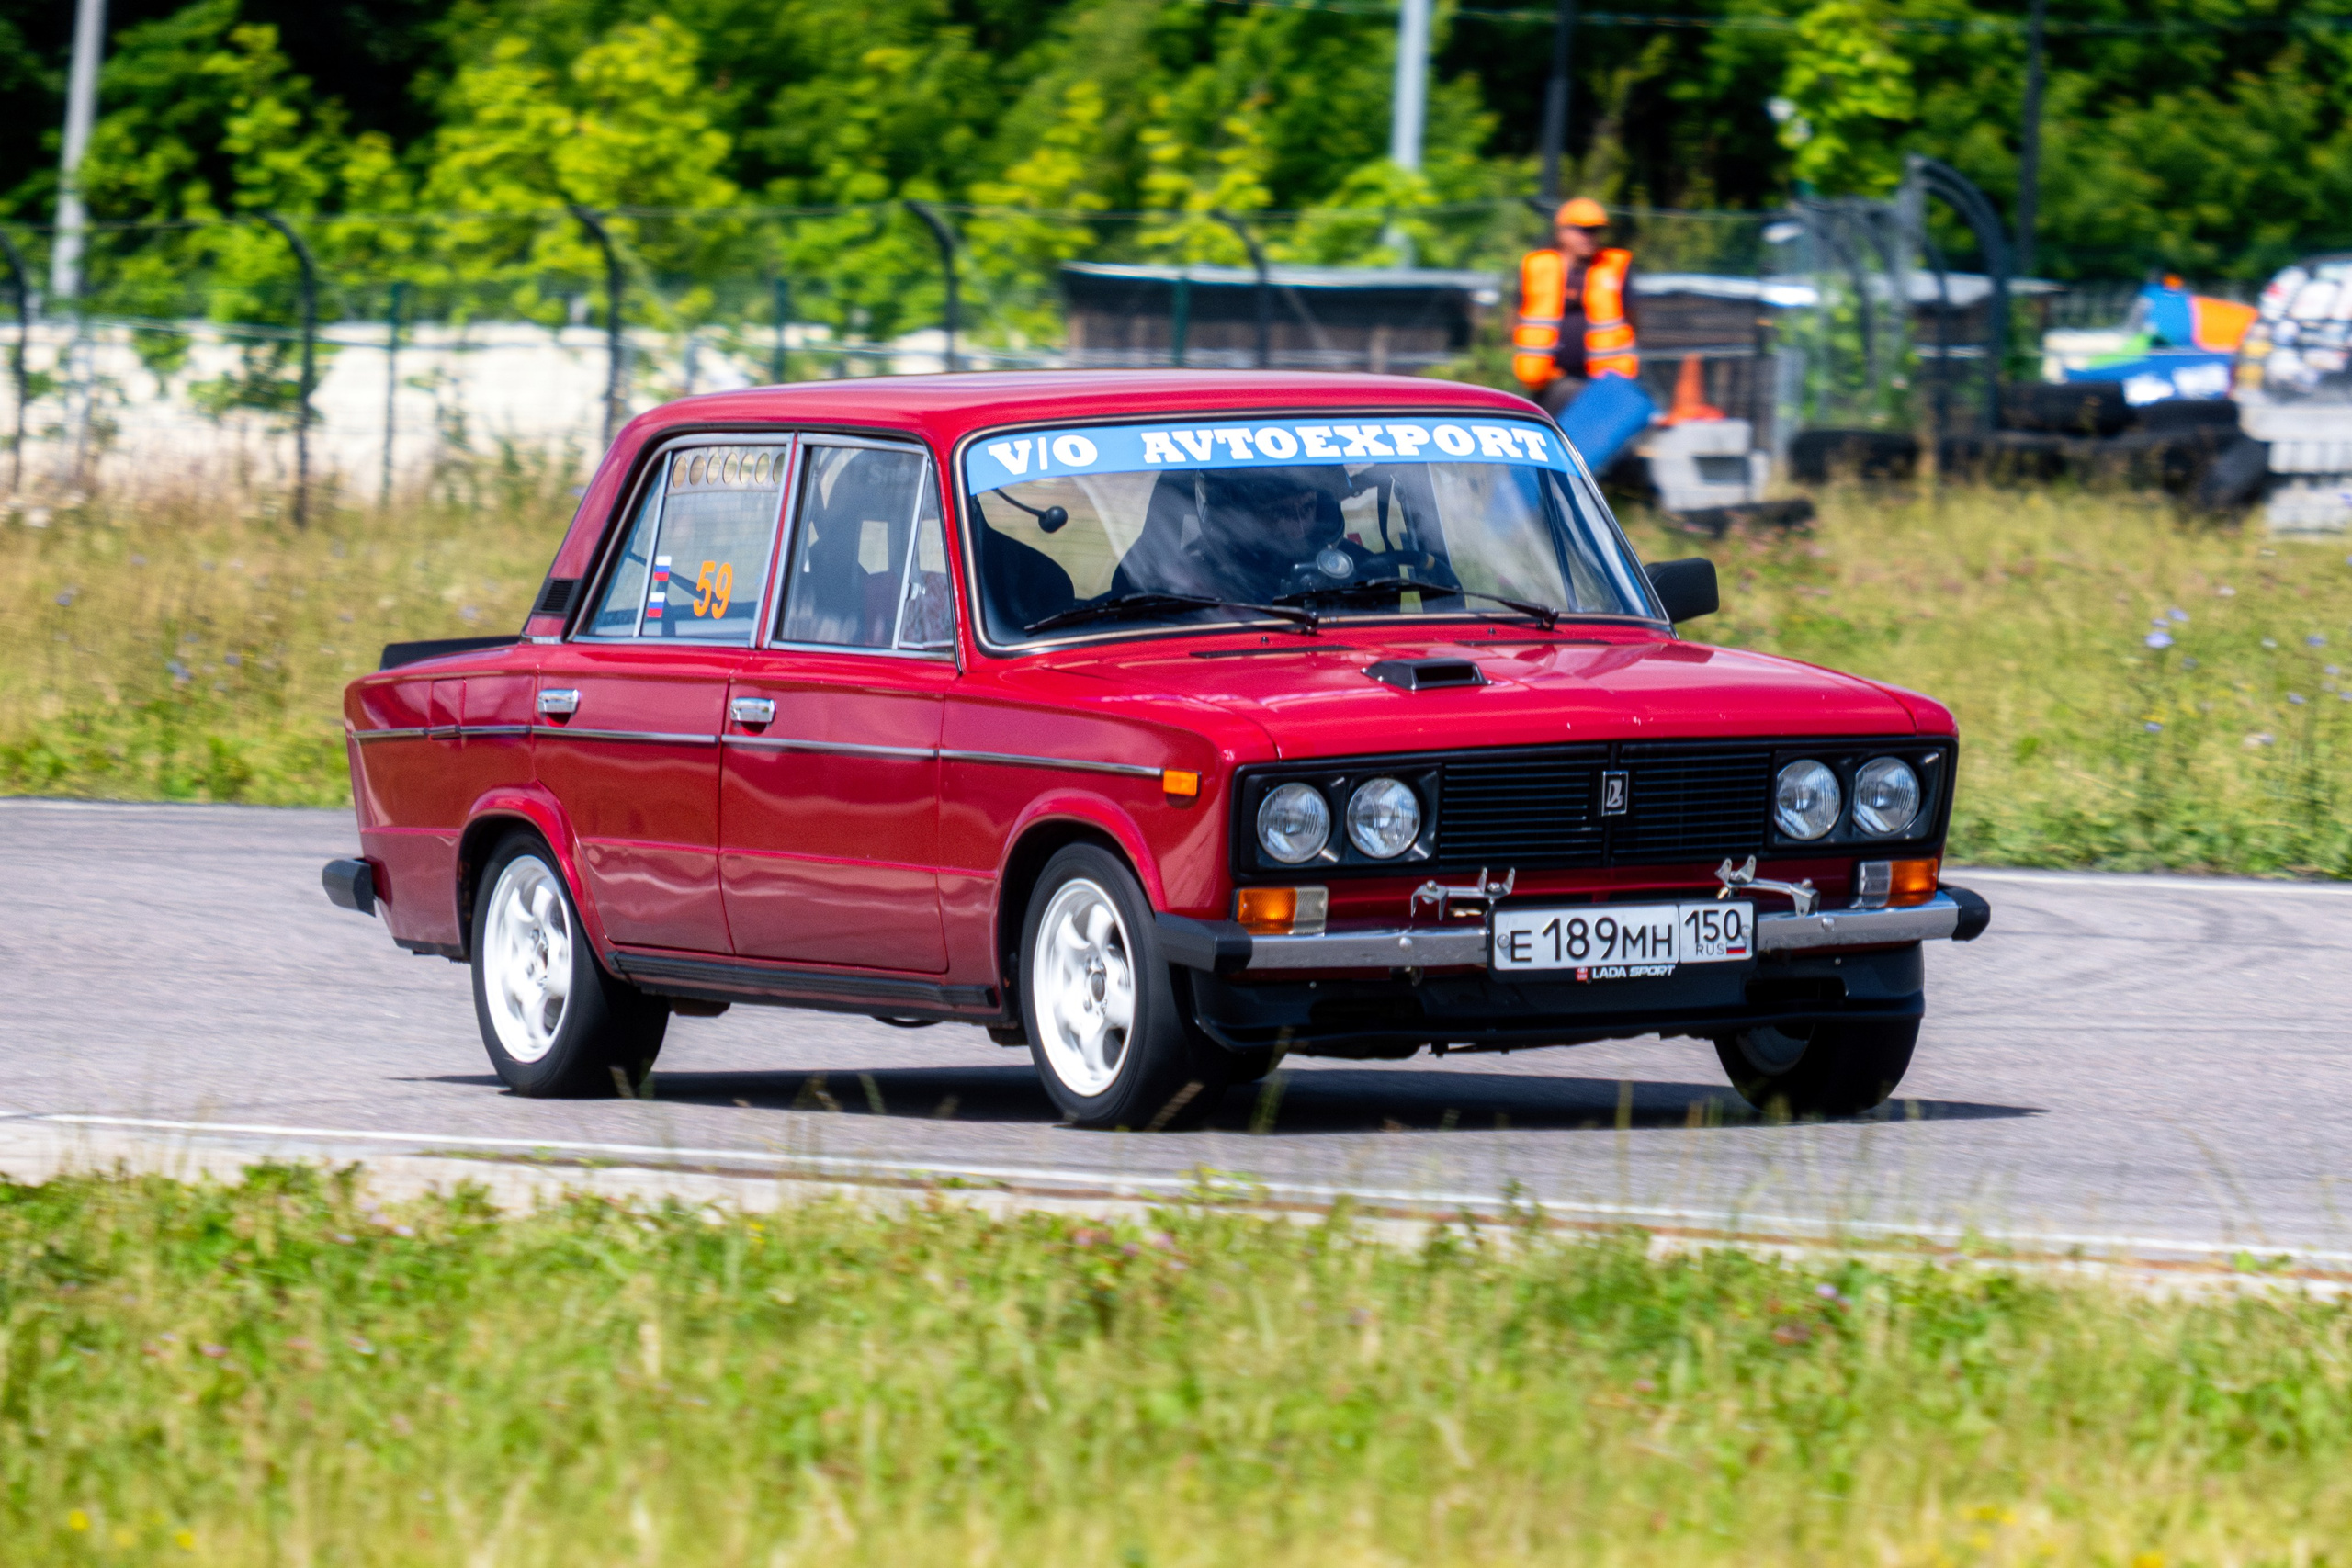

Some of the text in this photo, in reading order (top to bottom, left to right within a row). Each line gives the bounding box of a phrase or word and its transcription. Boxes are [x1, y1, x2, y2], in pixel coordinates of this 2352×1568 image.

[1141, 424, 1549, 464] AVTOEXPORT
[694, 561, 733, 619] 59
[1684, 908, 1742, 943] 150
[1695, 943, 1724, 956] RUS
[1592, 967, 1626, 979] LADA
[1629, 964, 1676, 977] SPORT
